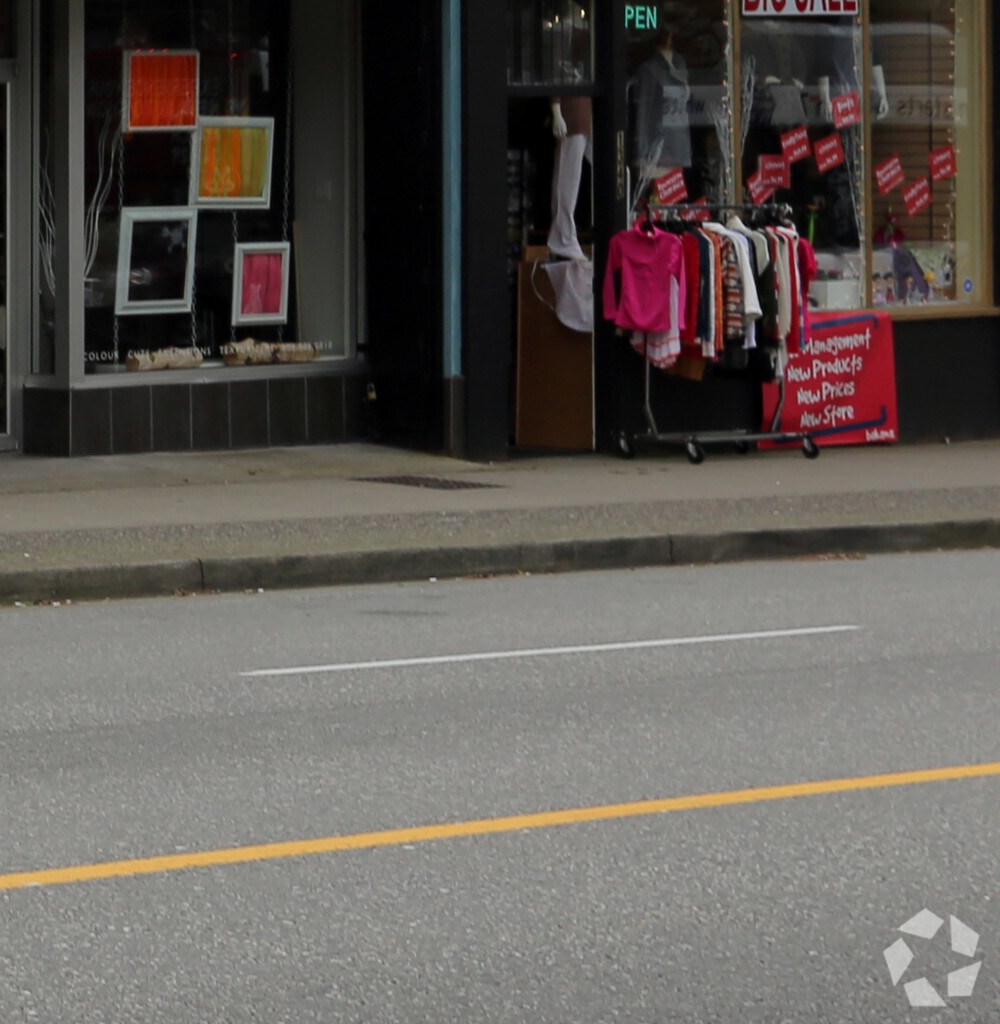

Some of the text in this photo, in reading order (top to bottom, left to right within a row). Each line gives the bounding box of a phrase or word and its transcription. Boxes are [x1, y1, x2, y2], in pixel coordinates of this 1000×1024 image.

[624, 4, 658, 29] PEN
[802, 327, 872, 356] Management
[787, 354, 863, 383] New Products
[797, 381, 856, 405] New Prices
[801, 405, 855, 428] New Store
